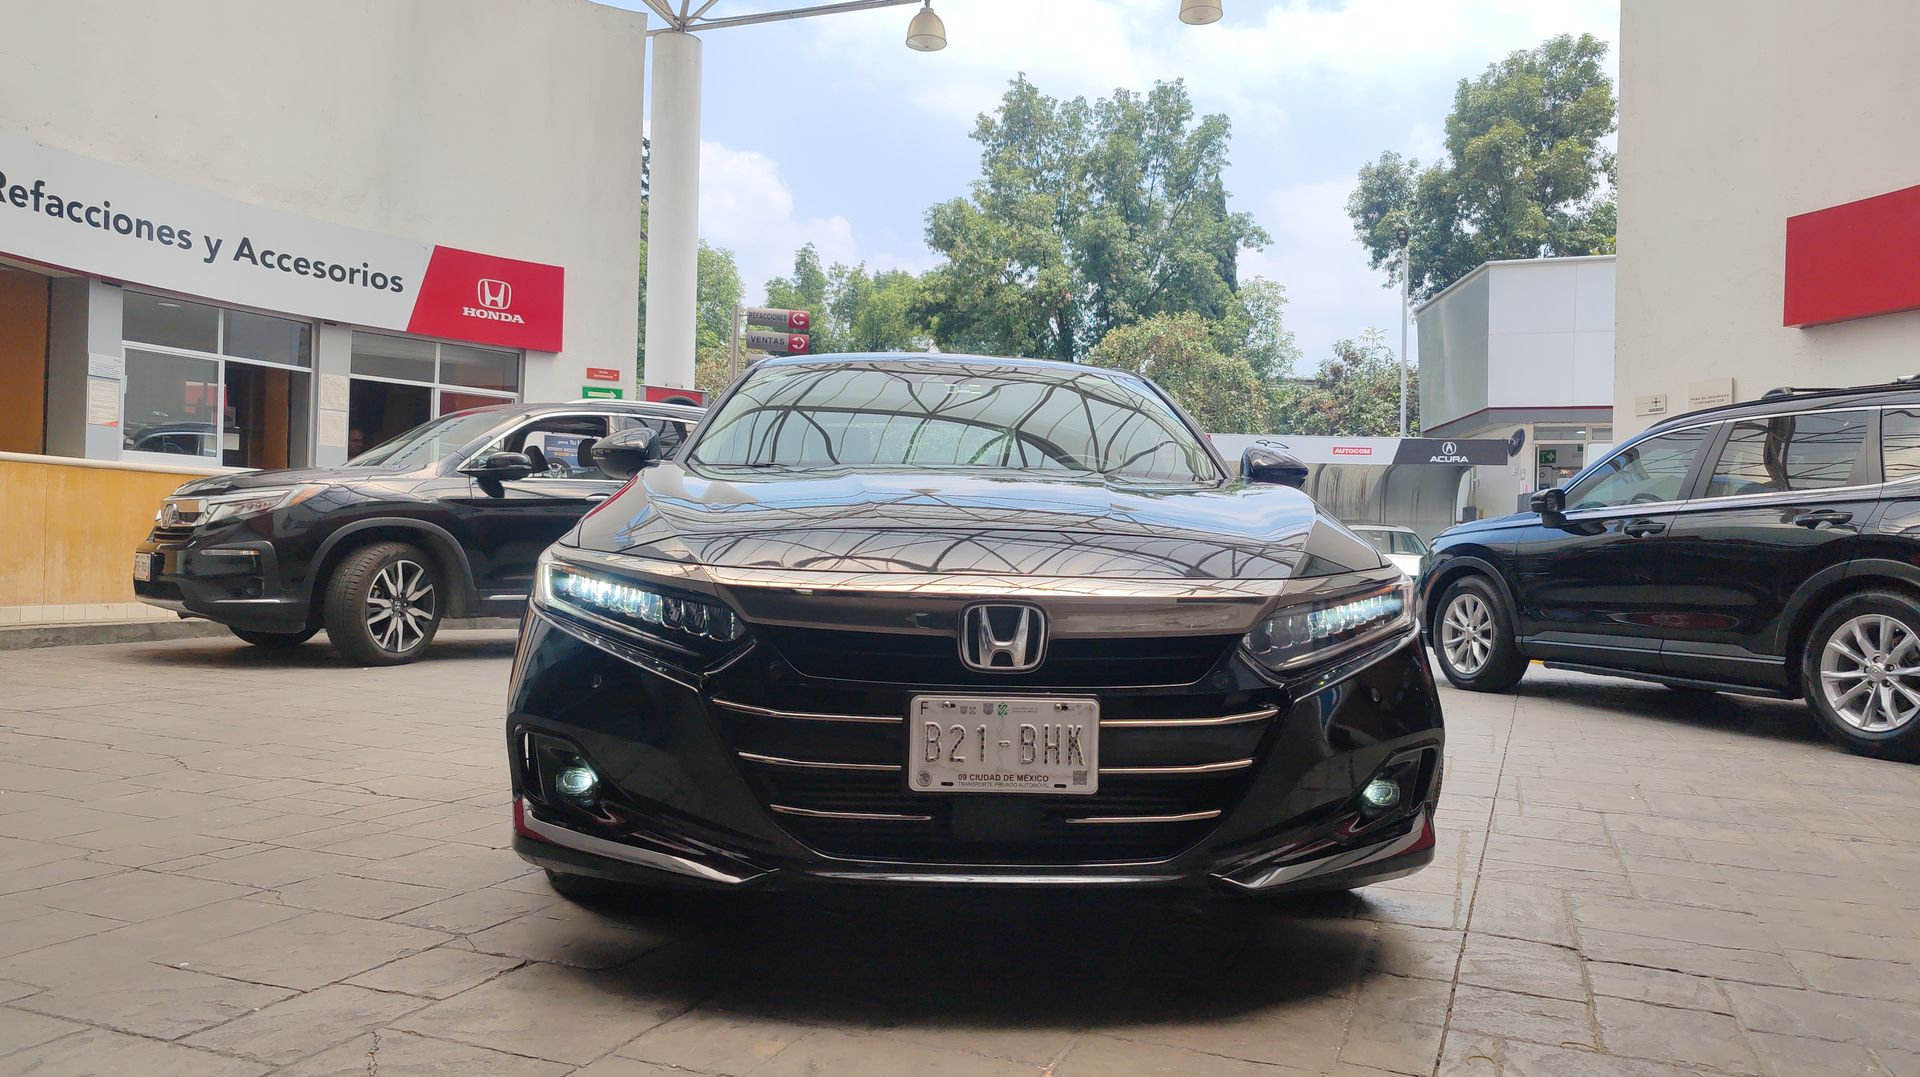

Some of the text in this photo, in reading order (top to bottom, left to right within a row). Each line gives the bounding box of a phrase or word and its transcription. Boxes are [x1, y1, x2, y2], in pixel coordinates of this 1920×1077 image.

[204, 232, 223, 264] y
[233, 237, 404, 294] Accesorios
[462, 306, 525, 324] HONDA
[748, 311, 788, 322] REFACCIONES
[751, 336, 785, 346] VENTAS
[1334, 447, 1372, 455] AUTOCOM
[1429, 455, 1469, 463] ACURA
[969, 774, 1001, 782] CIUDAD
[1003, 774, 1015, 782] DE
